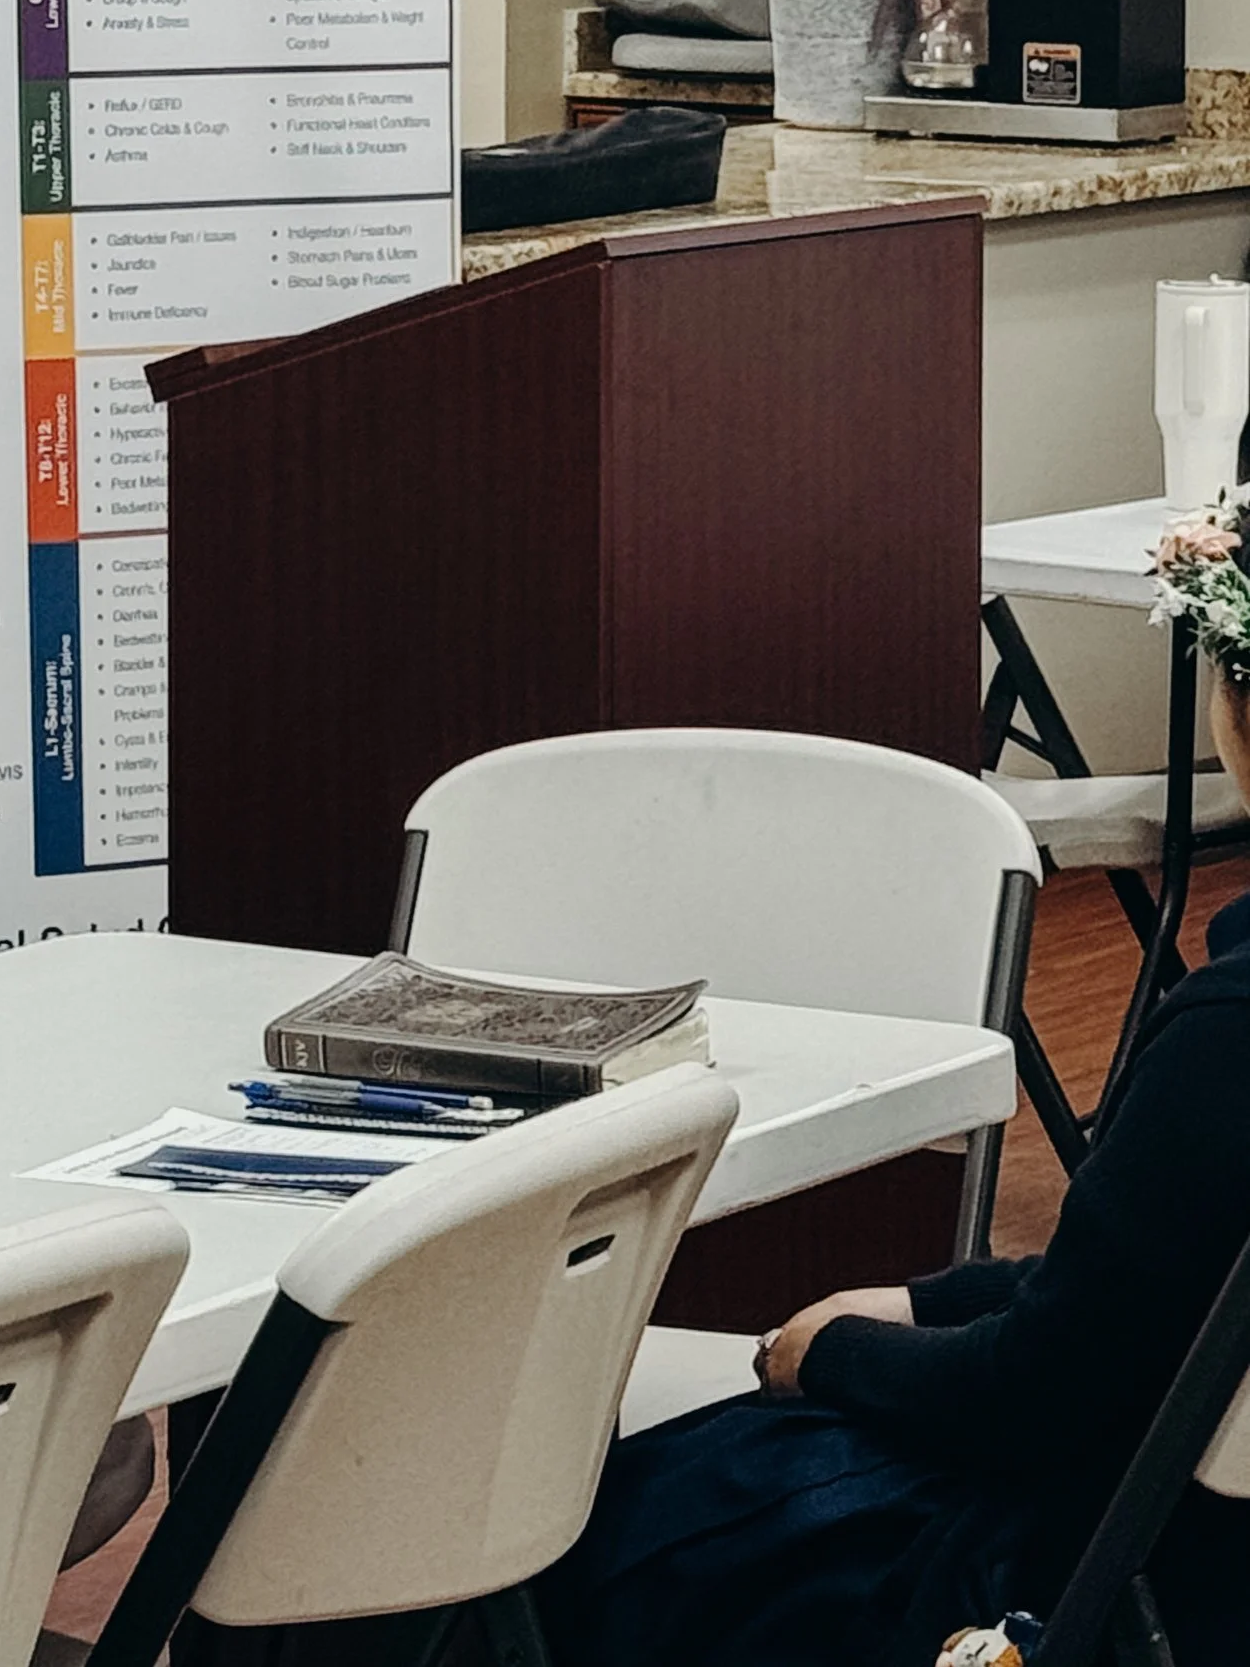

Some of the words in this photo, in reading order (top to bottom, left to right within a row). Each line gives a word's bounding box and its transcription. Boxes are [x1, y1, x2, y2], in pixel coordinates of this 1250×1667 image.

[48, 91, 62, 154] Thoracic
[49, 156, 65, 203] Upper
[56, 461, 69, 506] Lower
